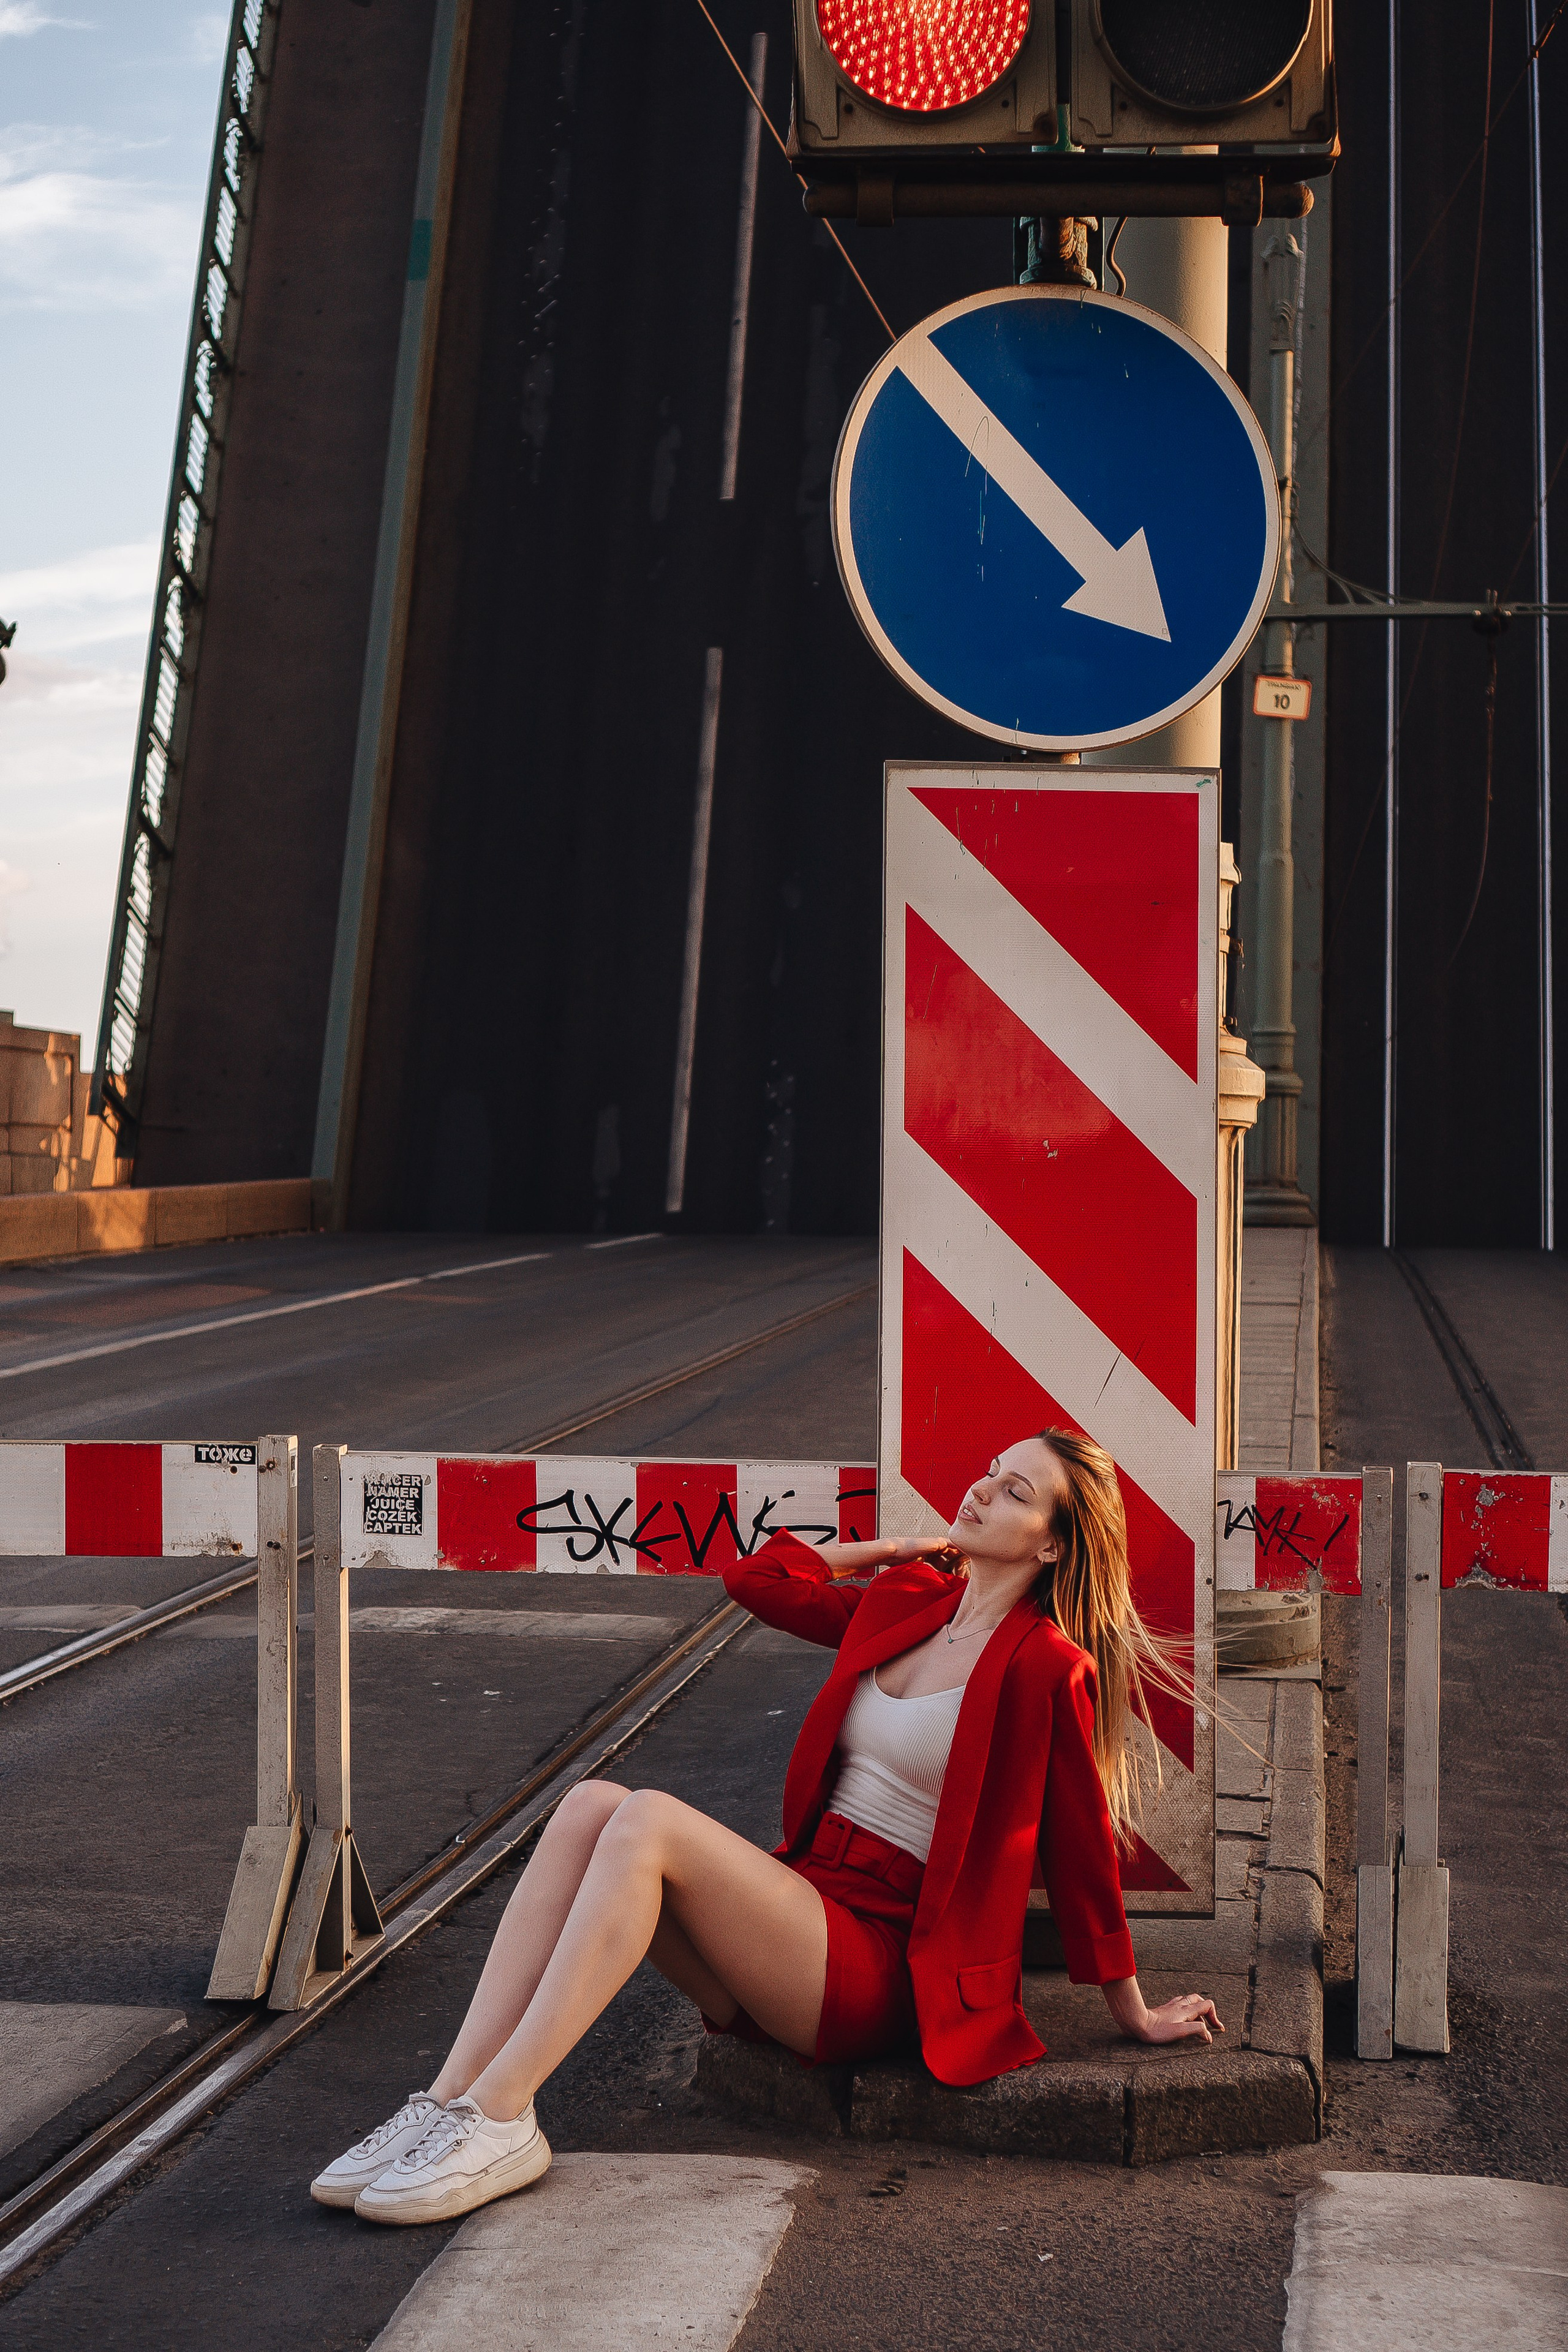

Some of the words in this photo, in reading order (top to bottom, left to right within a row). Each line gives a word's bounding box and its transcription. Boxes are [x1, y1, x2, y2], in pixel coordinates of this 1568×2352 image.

[1274, 693, 1290, 709] 10
[367, 1487, 420, 1498] NAMER
[371, 1498, 415, 1510] JUICE
[367, 1510, 418, 1523] COZEK
[364, 1521, 423, 1534] CAPTEK
